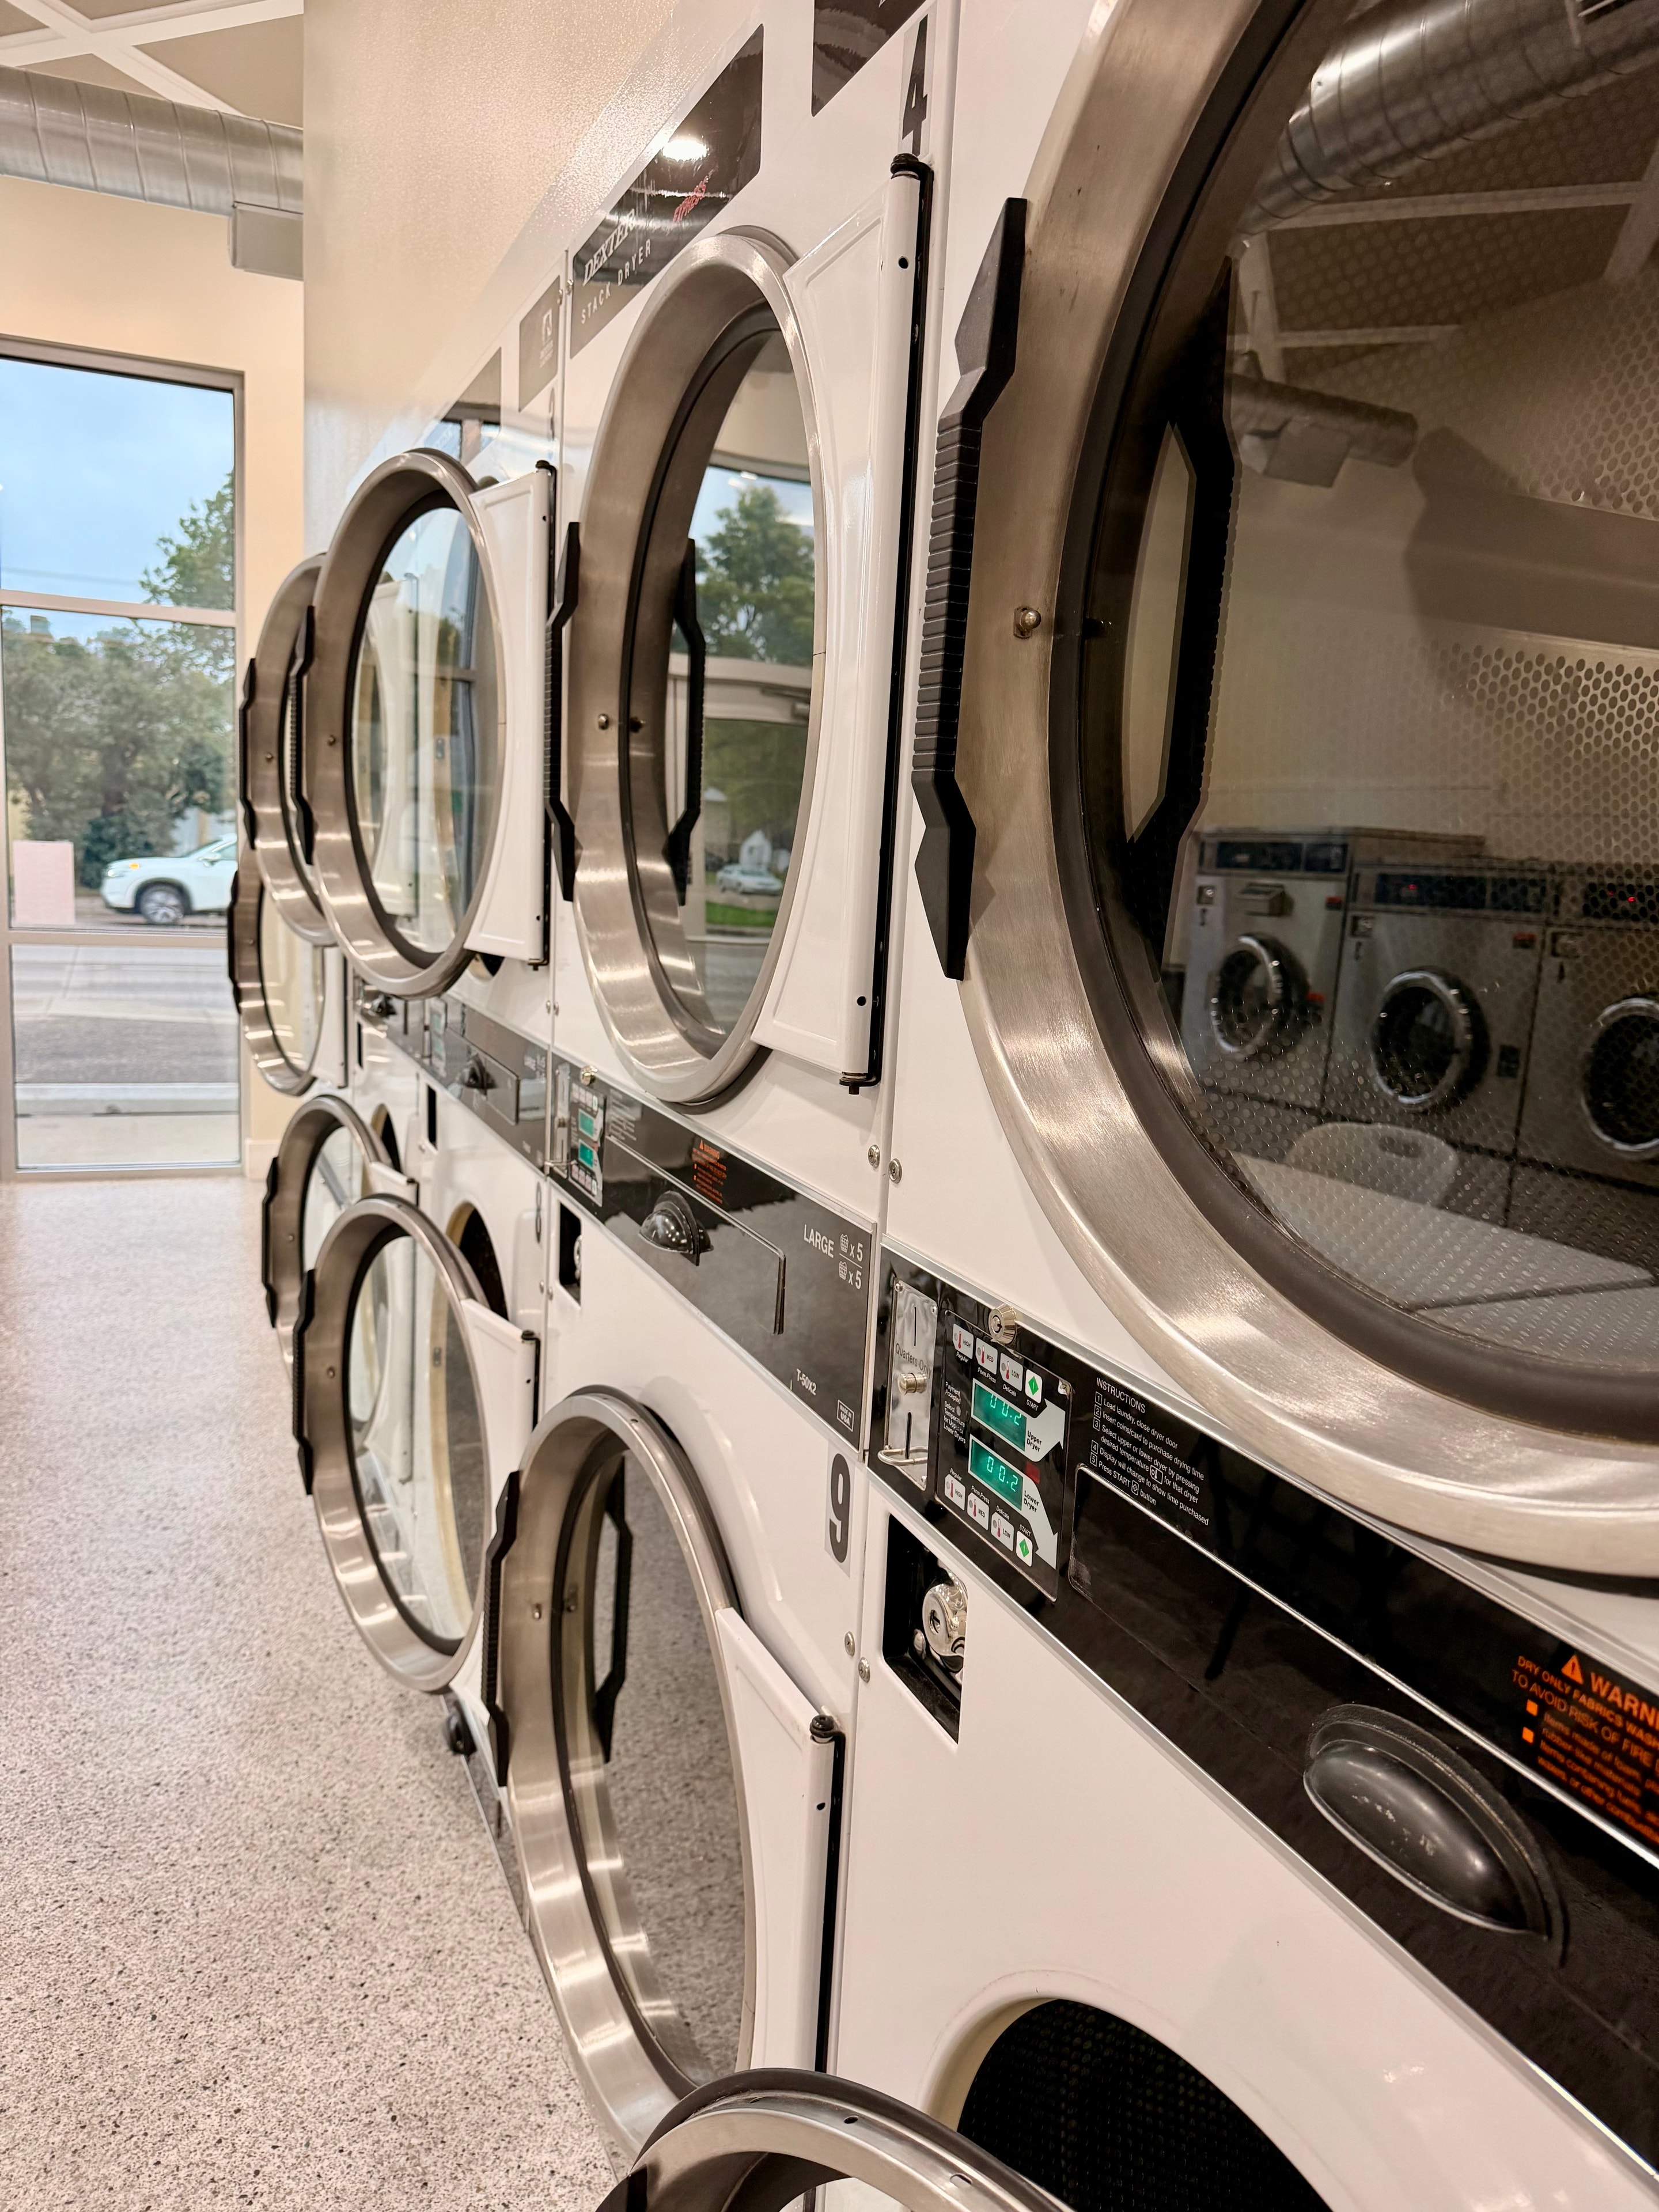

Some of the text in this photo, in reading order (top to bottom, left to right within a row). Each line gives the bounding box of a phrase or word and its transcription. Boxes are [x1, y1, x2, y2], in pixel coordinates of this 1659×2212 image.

[902, 14, 928, 157] 4
[582, 208, 635, 286] DEXTER
[581, 238, 651, 324] STACK DRYER
[536, 1181, 541, 1243] 8
[804, 1224, 835, 1259] LARGE
[857, 1243, 863, 1262] 5
[855, 1270, 862, 1290] 5
[896, 1342, 933, 1380] Quarters Only
[1011, 1369, 1020, 1379] LOW
[796, 1368, 817, 1396] T-50X2
[1002, 1384, 1017, 1397] Delicate
[1096, 1377, 1146, 1414] INSTRUCTIONS
[840, 1411, 850, 1426] USA
[1026, 1400, 1039, 1411] START
[1104, 1398, 1116, 1411] Load
[1137, 1419, 1150, 1432] close
[1152, 1425, 1164, 1441] dryer
[1165, 1437, 1177, 1449] door
[1027, 1430, 1042, 1445] Upper
[1027, 1439, 1040, 1452] Dryer
[1103, 1411, 1116, 1426] Insert
[1117, 1420, 1142, 1441] coins/card
[1143, 1437, 1148, 1445] to
[1149, 1440, 1173, 1461] purchase
[1174, 1456, 1191, 1474] drying
[1192, 1467, 1204, 1480] time
[1101, 1435, 1199, 1504] desired temperature for that dryer
[1102, 1425, 1117, 1440] Select
[1118, 1435, 1132, 1449] upper
[1132, 1445, 1138, 1453] or
[1139, 1448, 1153, 1462] lower
[1153, 1456, 1168, 1471] dryer
[1168, 1467, 1175, 1478] by
[1176, 1473, 1199, 1494] pressing
[1024, 1490, 1039, 1506] Lower
[1099, 1460, 1112, 1475] Press
[1113, 1471, 1131, 1487] START
[1140, 1489, 1156, 1505] button
[1100, 1447, 1117, 1465] Display
[1118, 1460, 1126, 1470] will
[1126, 1465, 1145, 1484] change
[1146, 1479, 1152, 1487] to
[1152, 1483, 1166, 1497] show
[1167, 1493, 1179, 1505] time
[1179, 1501, 1209, 1526] purchased
[829, 1453, 851, 1563] 9
[1024, 1499, 1037, 1513] Dryer
[1002, 1528, 1011, 1539] LOW
[1019, 1524, 1031, 1537] START
[1518, 1656, 1541, 1676] DRY
[1541, 1671, 1571, 1695] ONLY
[1573, 1689, 1624, 1728] FABRICS
[1513, 1671, 1653, 1768] TO AVOID RISK OF FIRE
